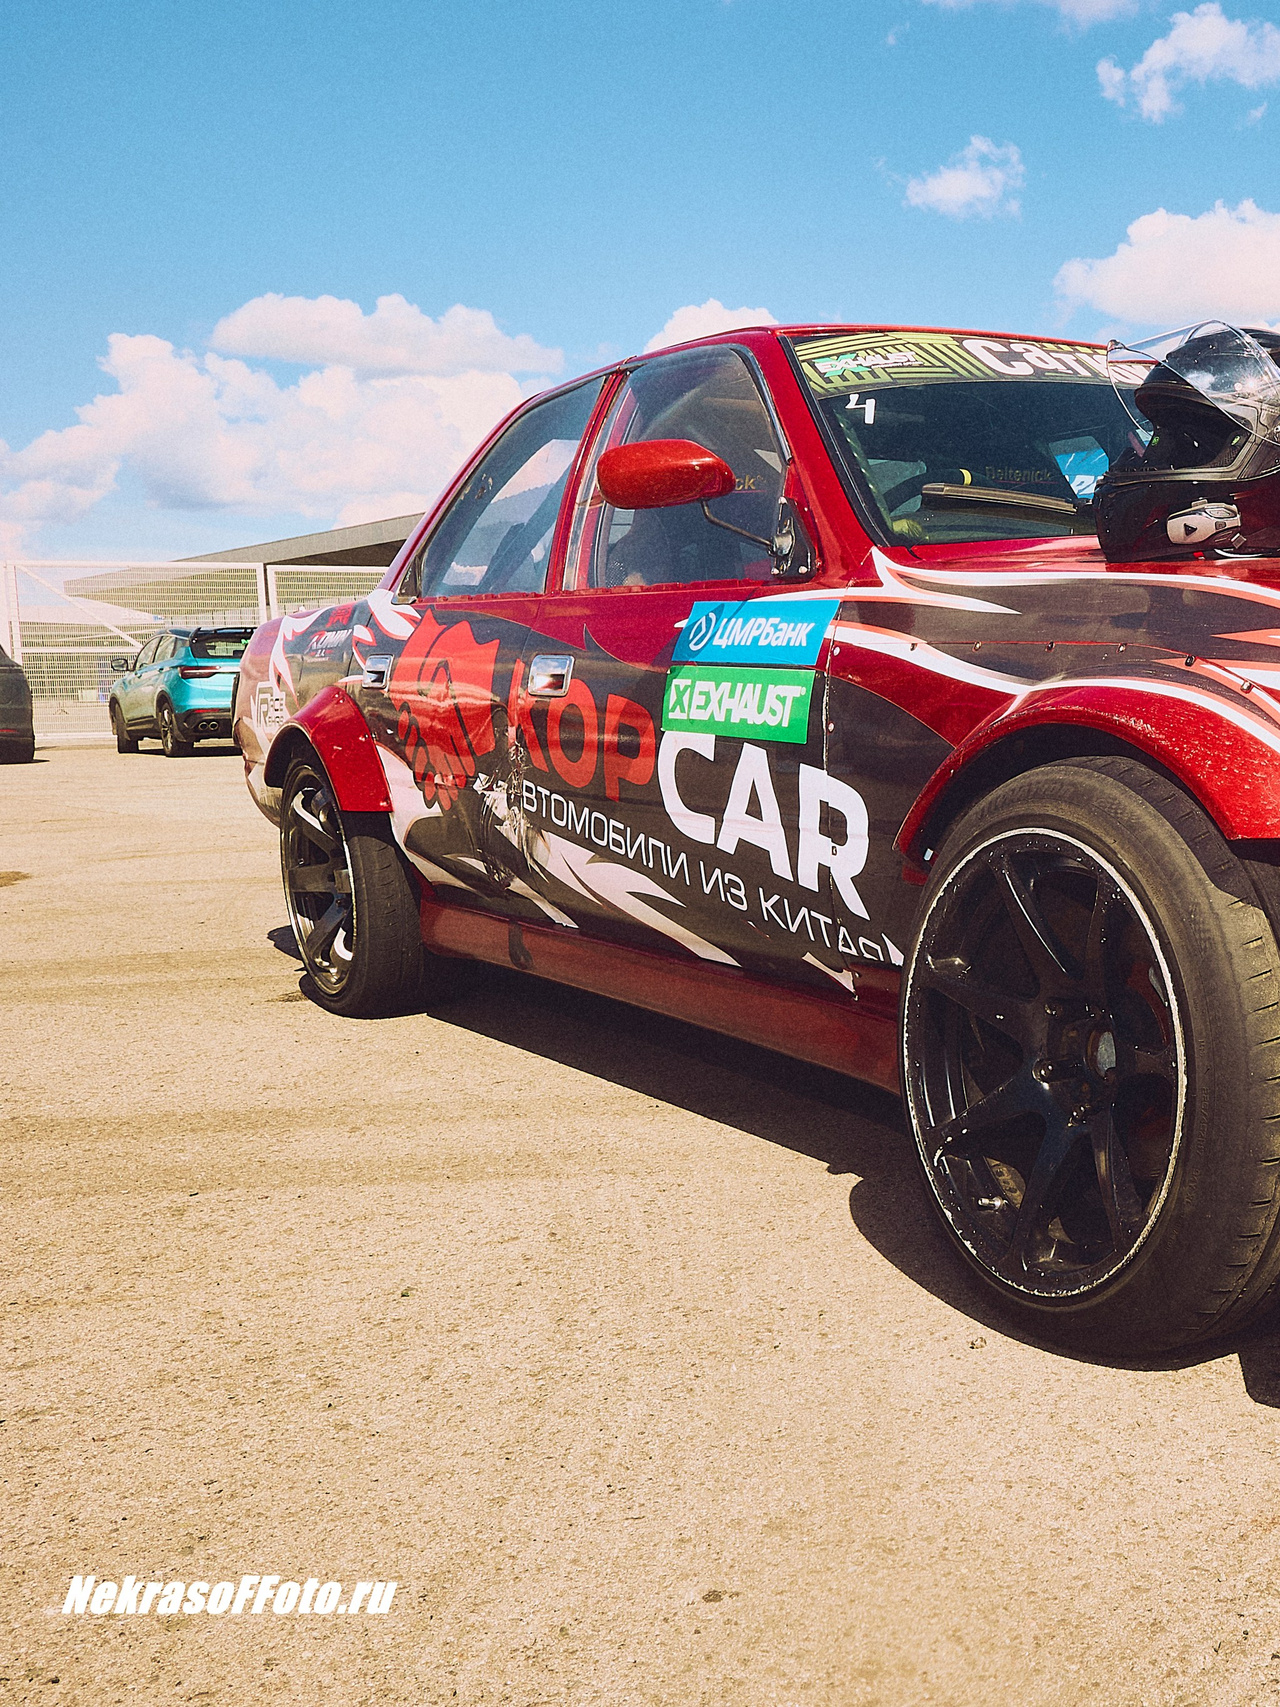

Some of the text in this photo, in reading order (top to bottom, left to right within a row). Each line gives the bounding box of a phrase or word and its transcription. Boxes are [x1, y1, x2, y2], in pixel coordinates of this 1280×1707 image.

[845, 393, 876, 425] 4
[712, 617, 816, 649] ЦМРБанк
[689, 681, 803, 728] EXHAUST
[512, 774, 885, 962] ВТОМОБИЛИ ИЗ КИТАЯ
